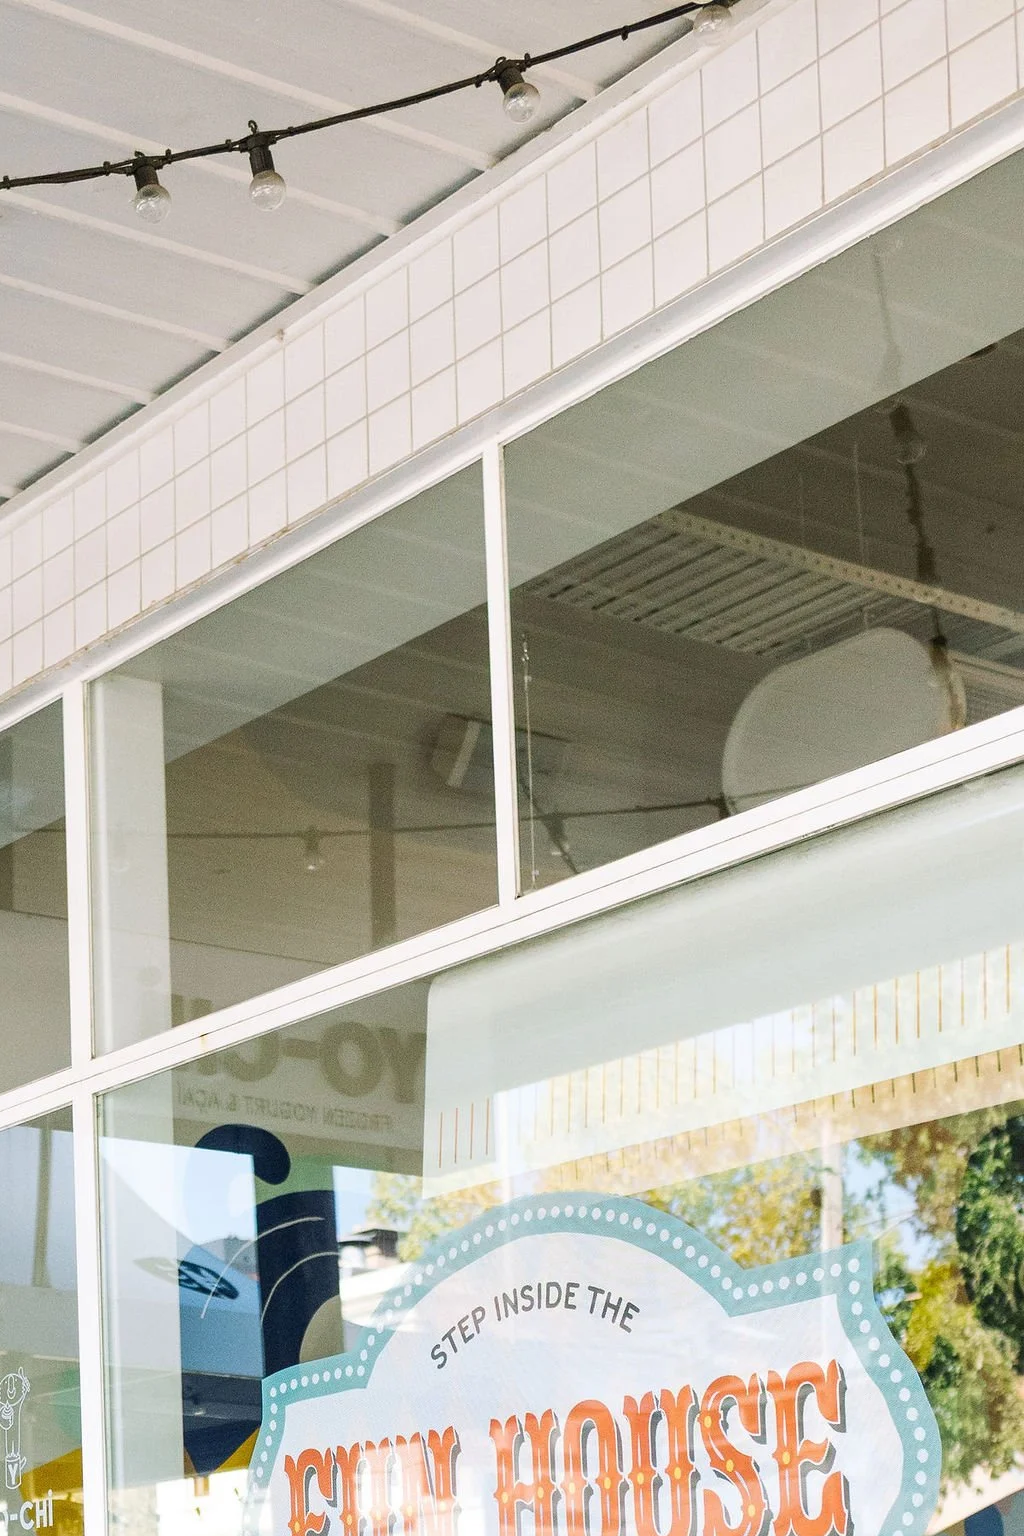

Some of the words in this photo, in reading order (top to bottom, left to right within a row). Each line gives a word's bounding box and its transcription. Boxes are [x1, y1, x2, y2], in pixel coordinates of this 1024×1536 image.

[430, 1307, 487, 1370] STEP
[494, 1280, 579, 1322] INSIDE
[587, 1284, 641, 1334] THE
